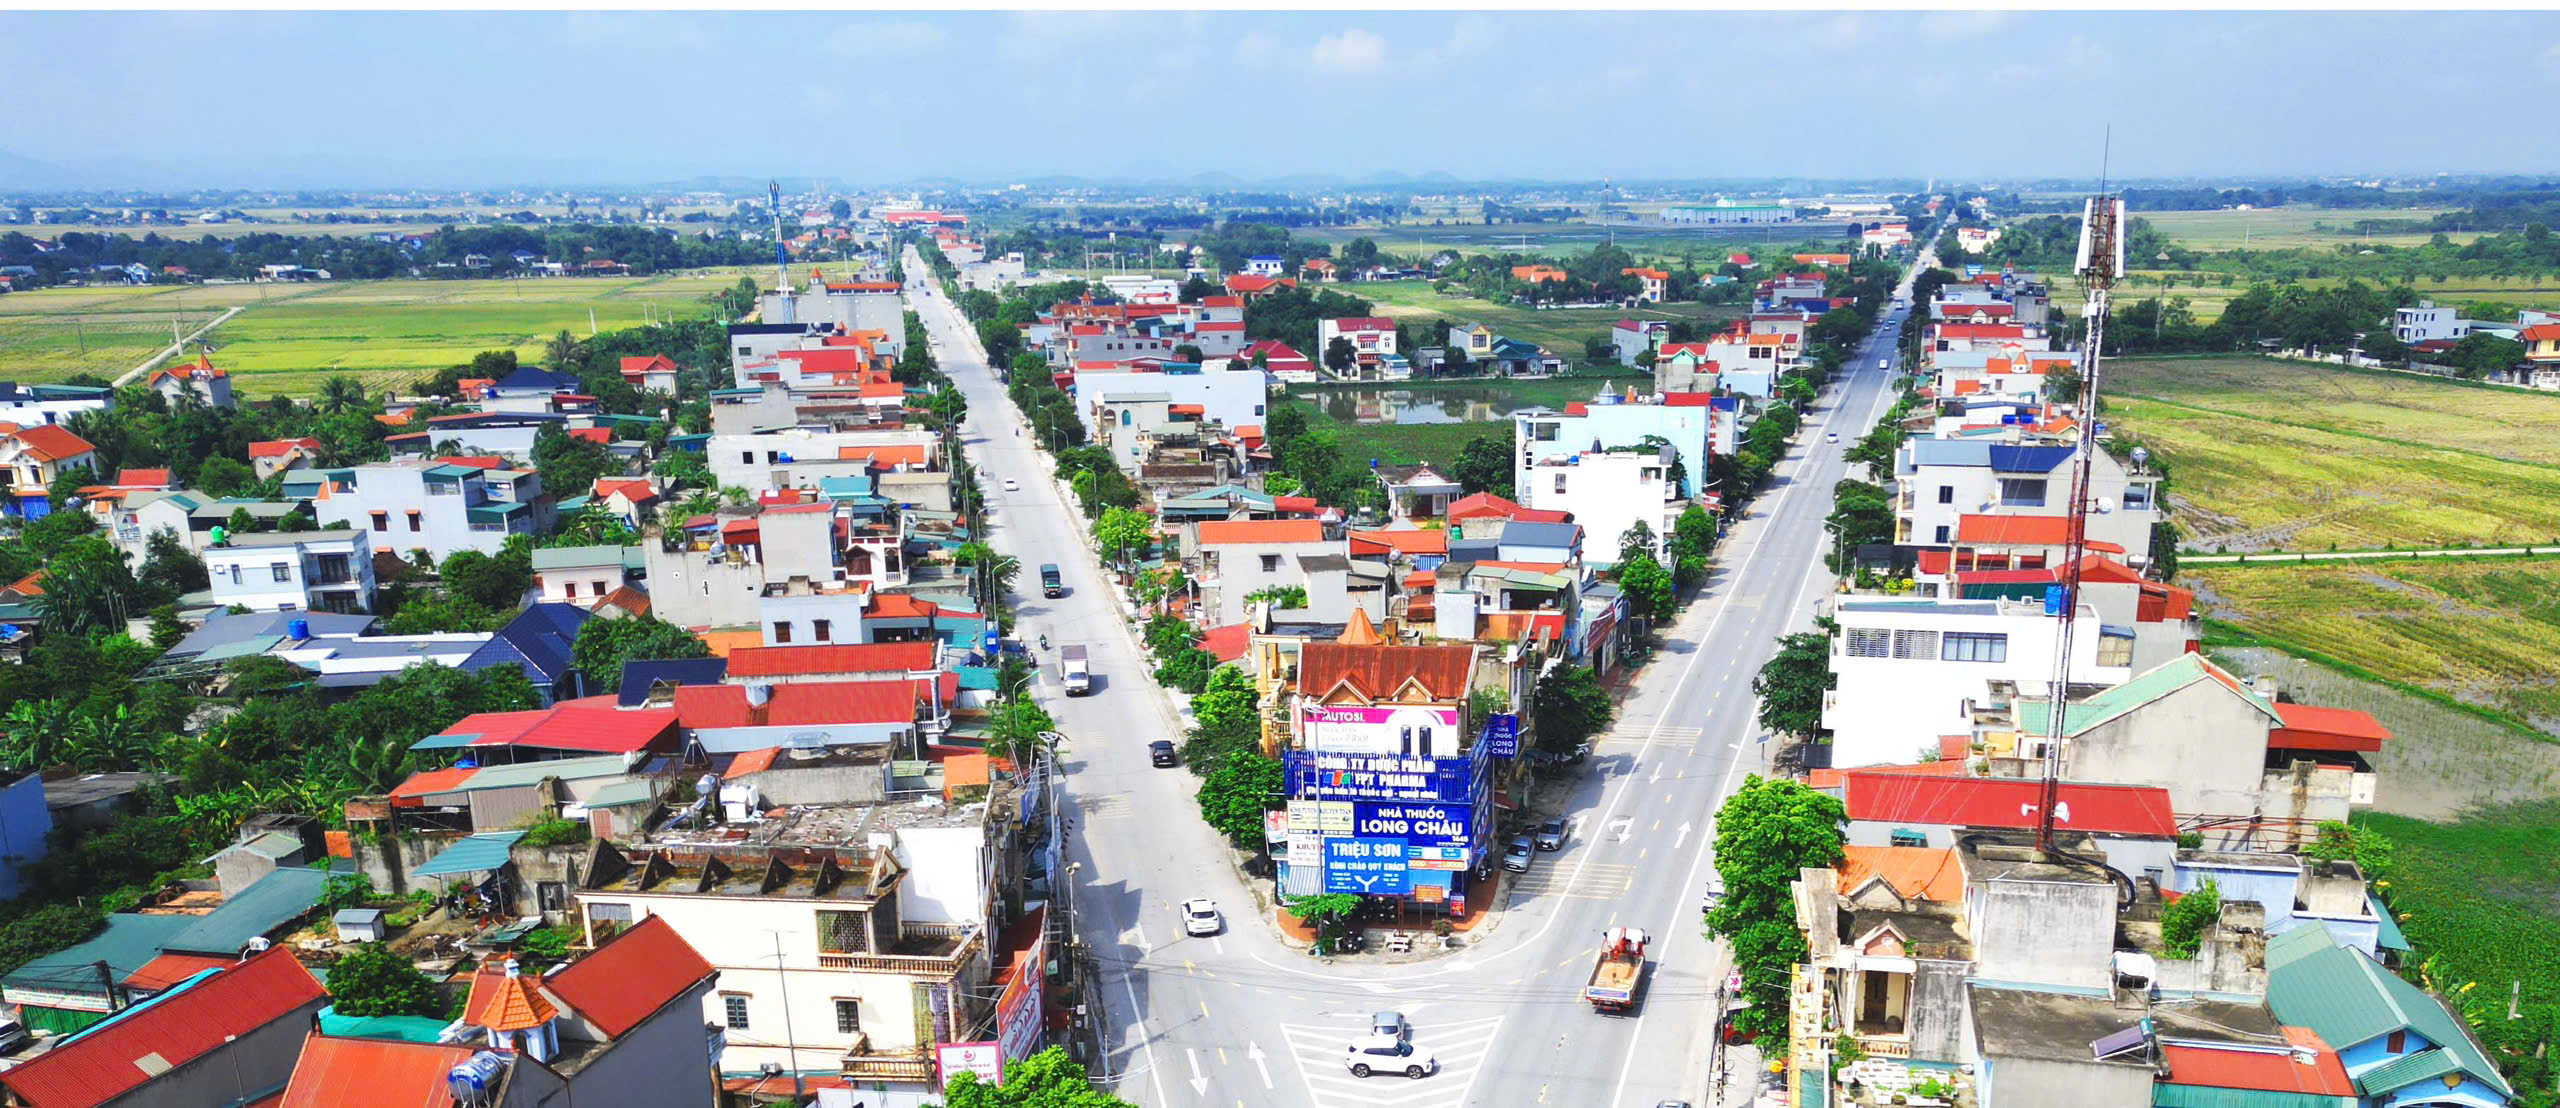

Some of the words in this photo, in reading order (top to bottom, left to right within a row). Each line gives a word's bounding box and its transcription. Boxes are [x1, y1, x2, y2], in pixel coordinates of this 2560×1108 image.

[1491, 747, 1514, 755] CHÂU
[1354, 773, 1375, 786] FPT
[1379, 773, 1427, 788] PHARMA
[1378, 806, 1403, 818] NHÀ
[1405, 805, 1445, 820] THUỐC
[1361, 819, 1409, 834] LONG
[1414, 819, 1463, 836] CHÂU
[1331, 841, 1370, 859] TRIỆU
[1373, 842, 1402, 858] SƠN
